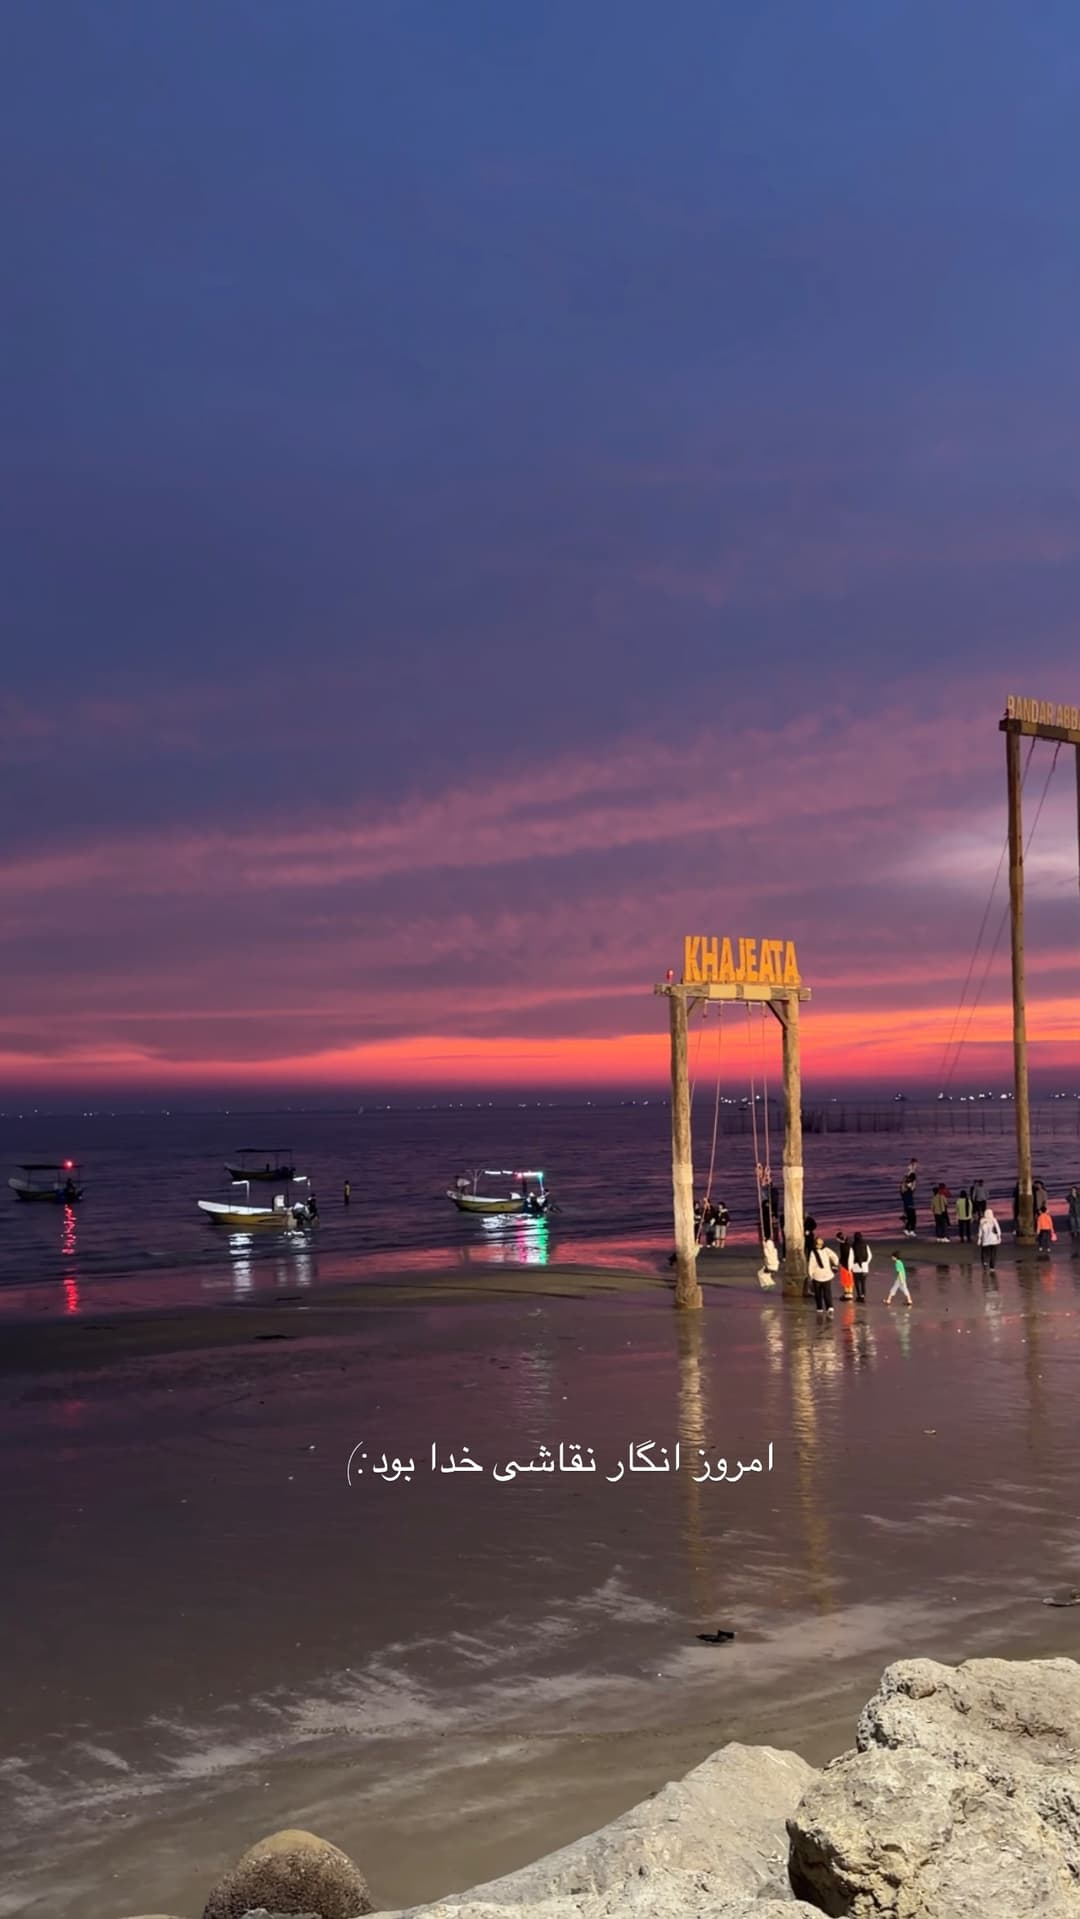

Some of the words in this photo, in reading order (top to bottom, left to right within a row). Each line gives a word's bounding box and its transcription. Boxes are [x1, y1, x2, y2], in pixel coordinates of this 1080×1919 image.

[1008, 695, 1054, 726] BANDAR
[1056, 703, 1080, 731] ABB
[684, 935, 801, 984] KHAJEATA
